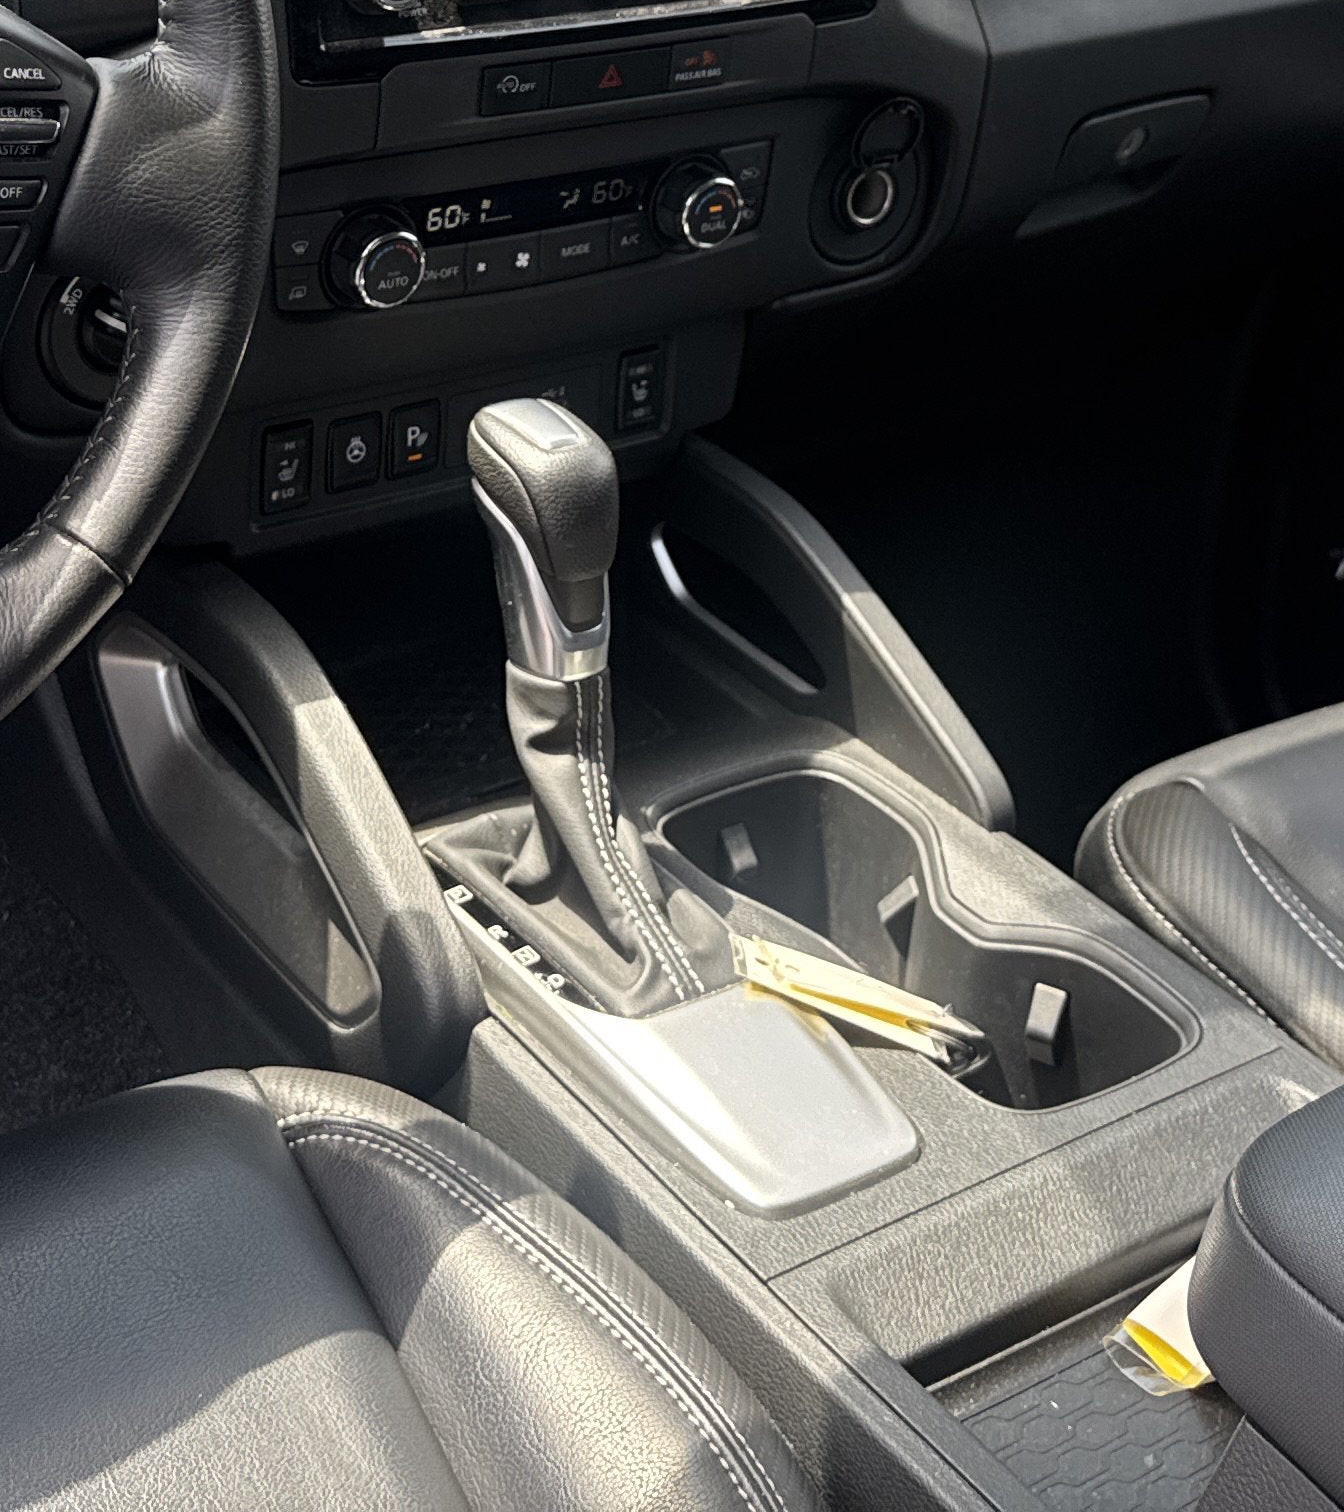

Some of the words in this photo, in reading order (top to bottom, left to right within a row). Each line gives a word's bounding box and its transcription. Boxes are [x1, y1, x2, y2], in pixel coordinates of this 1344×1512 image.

[3, 67, 46, 80] CANCEL
[519, 81, 537, 93] OFF
[700, 220, 727, 234] DUAL
[620, 232, 641, 247] A/C
[560, 242, 591, 257] MODE
[422, 265, 460, 281] ON-OFF
[377, 275, 409, 290] AUTO
[281, 487, 295, 499] LO
